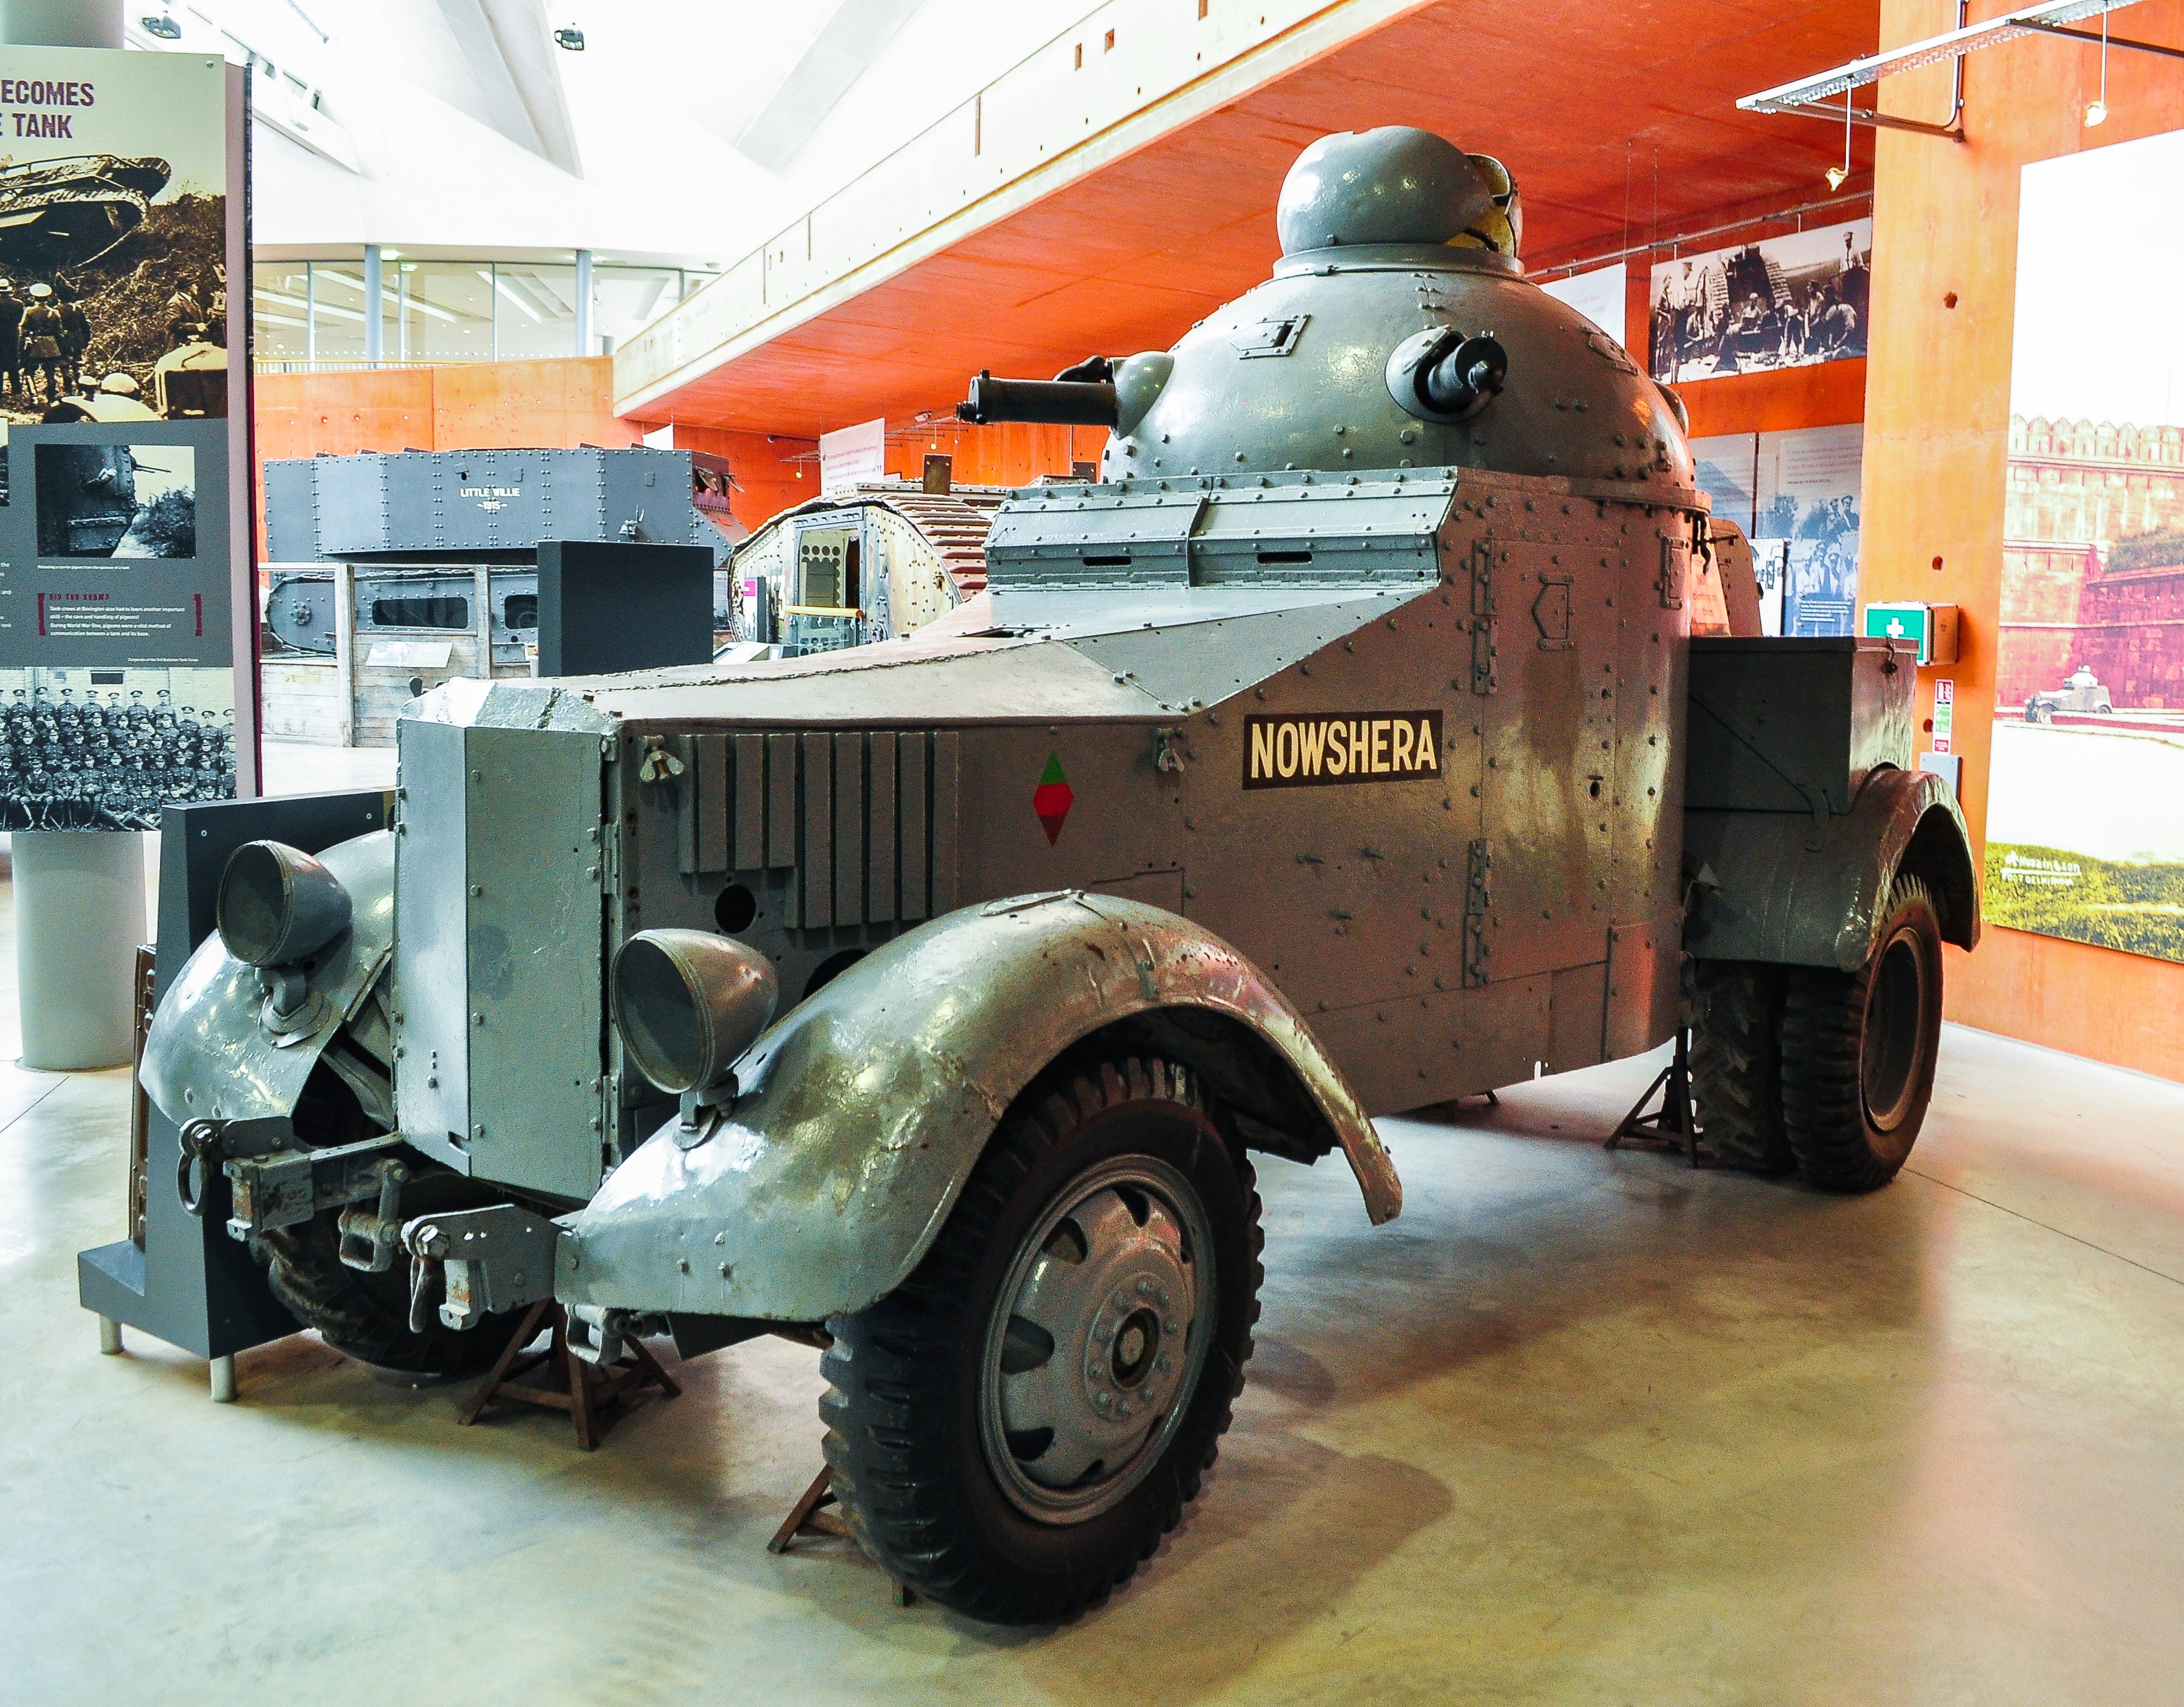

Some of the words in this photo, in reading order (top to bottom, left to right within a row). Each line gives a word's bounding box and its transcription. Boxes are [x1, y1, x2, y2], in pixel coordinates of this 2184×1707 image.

[12, 113, 73, 139] TANK
[460, 488, 490, 497] LITTLE
[492, 487, 520, 497] WILLIE
[482, 501, 500, 509] 1915
[1251, 720, 1437, 778] NOWSHERA
